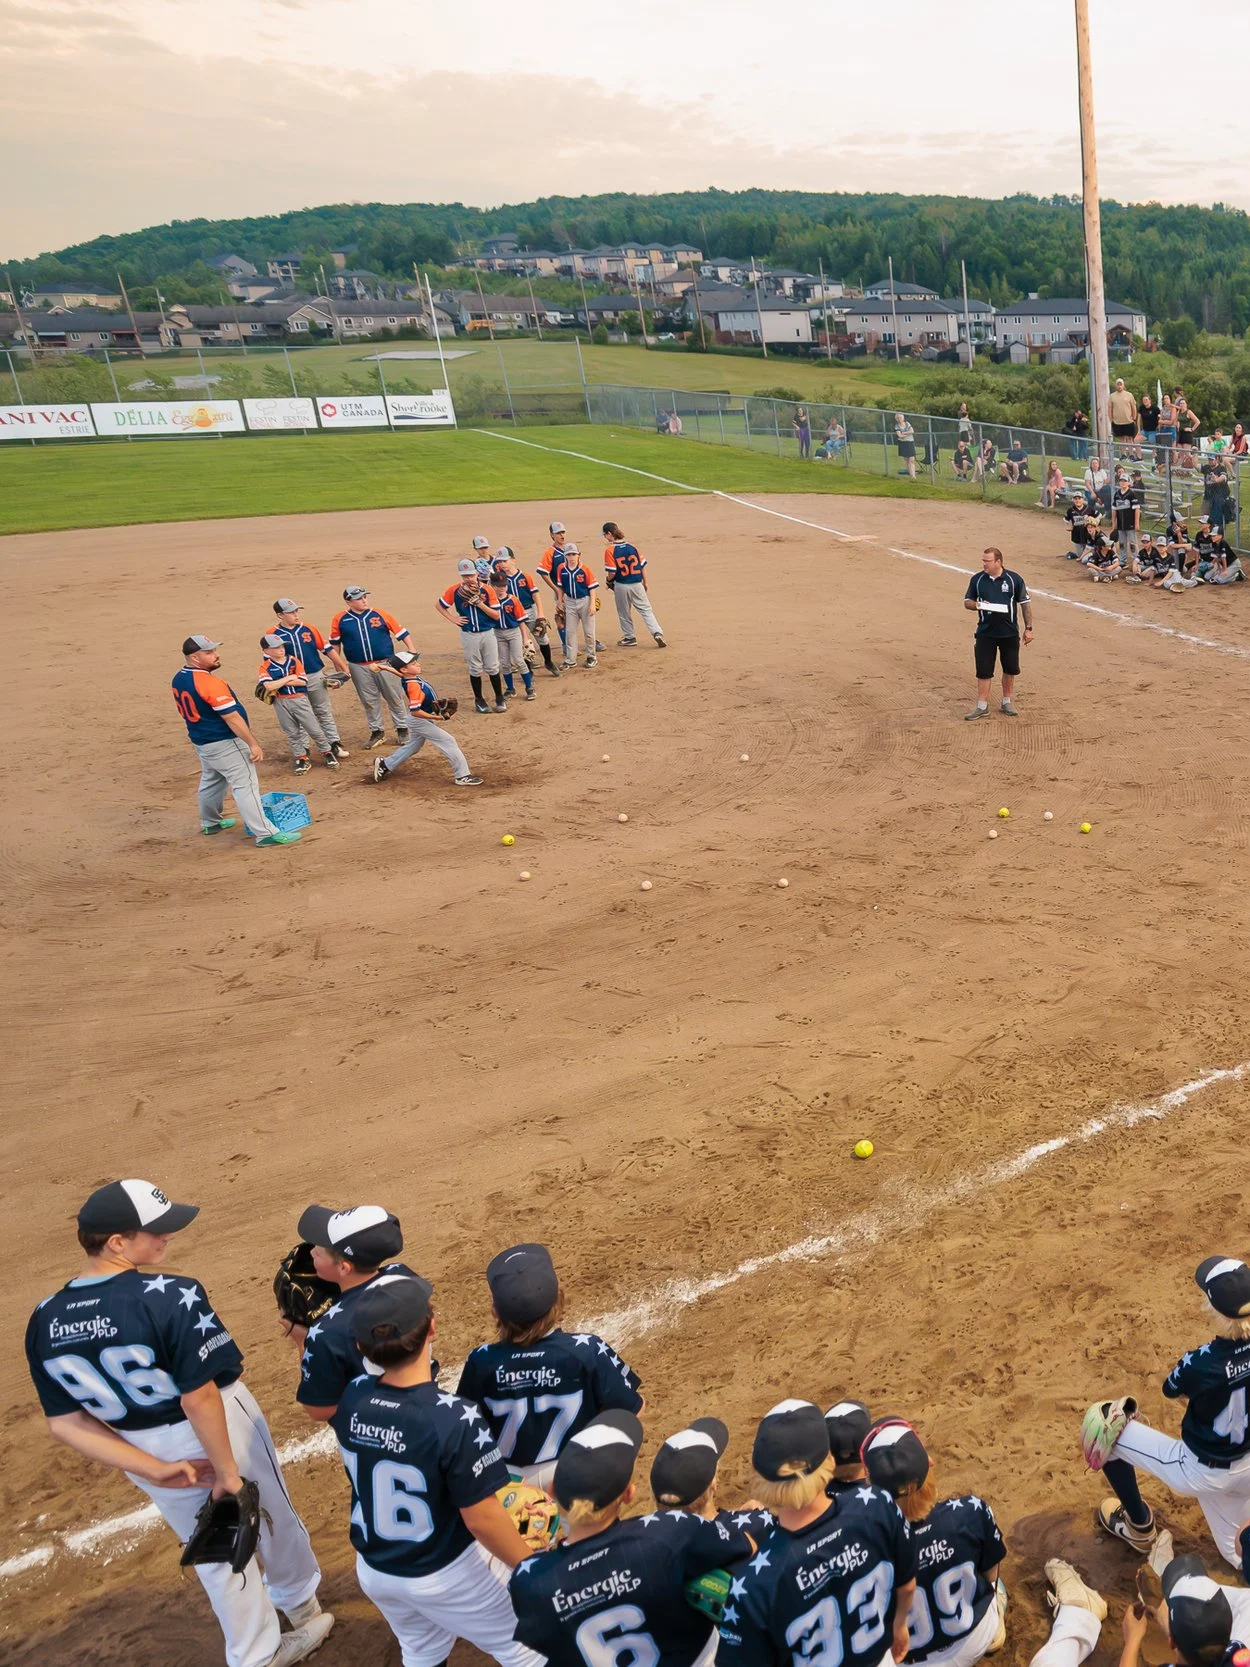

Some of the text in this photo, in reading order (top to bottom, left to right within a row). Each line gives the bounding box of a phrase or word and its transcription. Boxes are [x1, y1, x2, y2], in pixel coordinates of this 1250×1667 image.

[114, 408, 167, 426] DÉLIA
[342, 409, 384, 417] CANADA
[59, 425, 90, 435] ESTRIE
[616, 554, 642, 578] 52
[171, 687, 201, 723] 60
[98, 1327, 118, 1339] PLP
[43, 1344, 182, 1422] 96
[541, 1377, 561, 1387] PLP
[484, 1389, 583, 1464] 77
[386, 1440, 406, 1454] PLP
[849, 1549, 869, 1571] PLP
[918, 1539, 948, 1566] rgie
[936, 1547, 955, 1564] PLP
[616, 1577, 642, 1596] PLP
[785, 1560, 894, 1667] 33
[576, 1604, 661, 1667] 6
